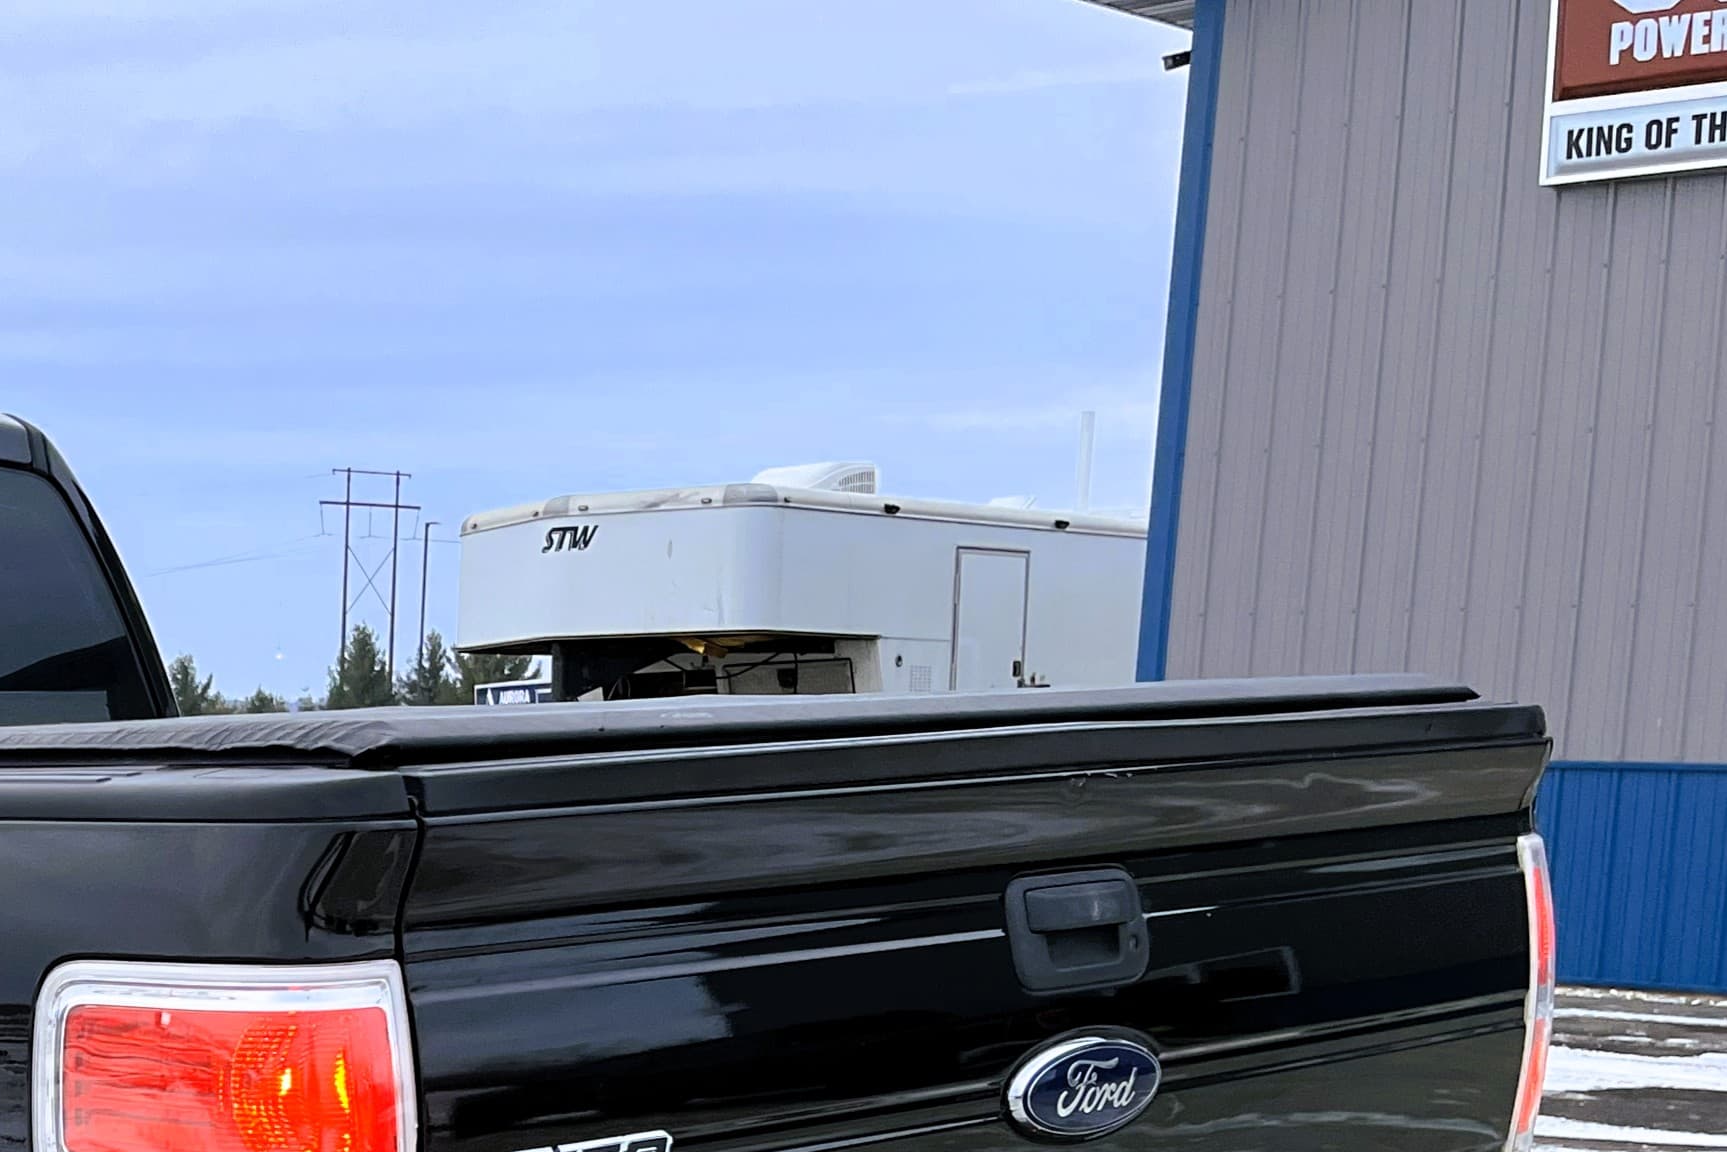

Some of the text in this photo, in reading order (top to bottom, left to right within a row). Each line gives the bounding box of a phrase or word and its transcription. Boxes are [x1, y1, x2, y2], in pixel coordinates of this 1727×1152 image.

[1610, 9, 1727, 65] POWER
[1566, 111, 1727, 160] KING OF TH
[542, 525, 599, 553] STW
[1057, 1057, 1136, 1117] Ford
